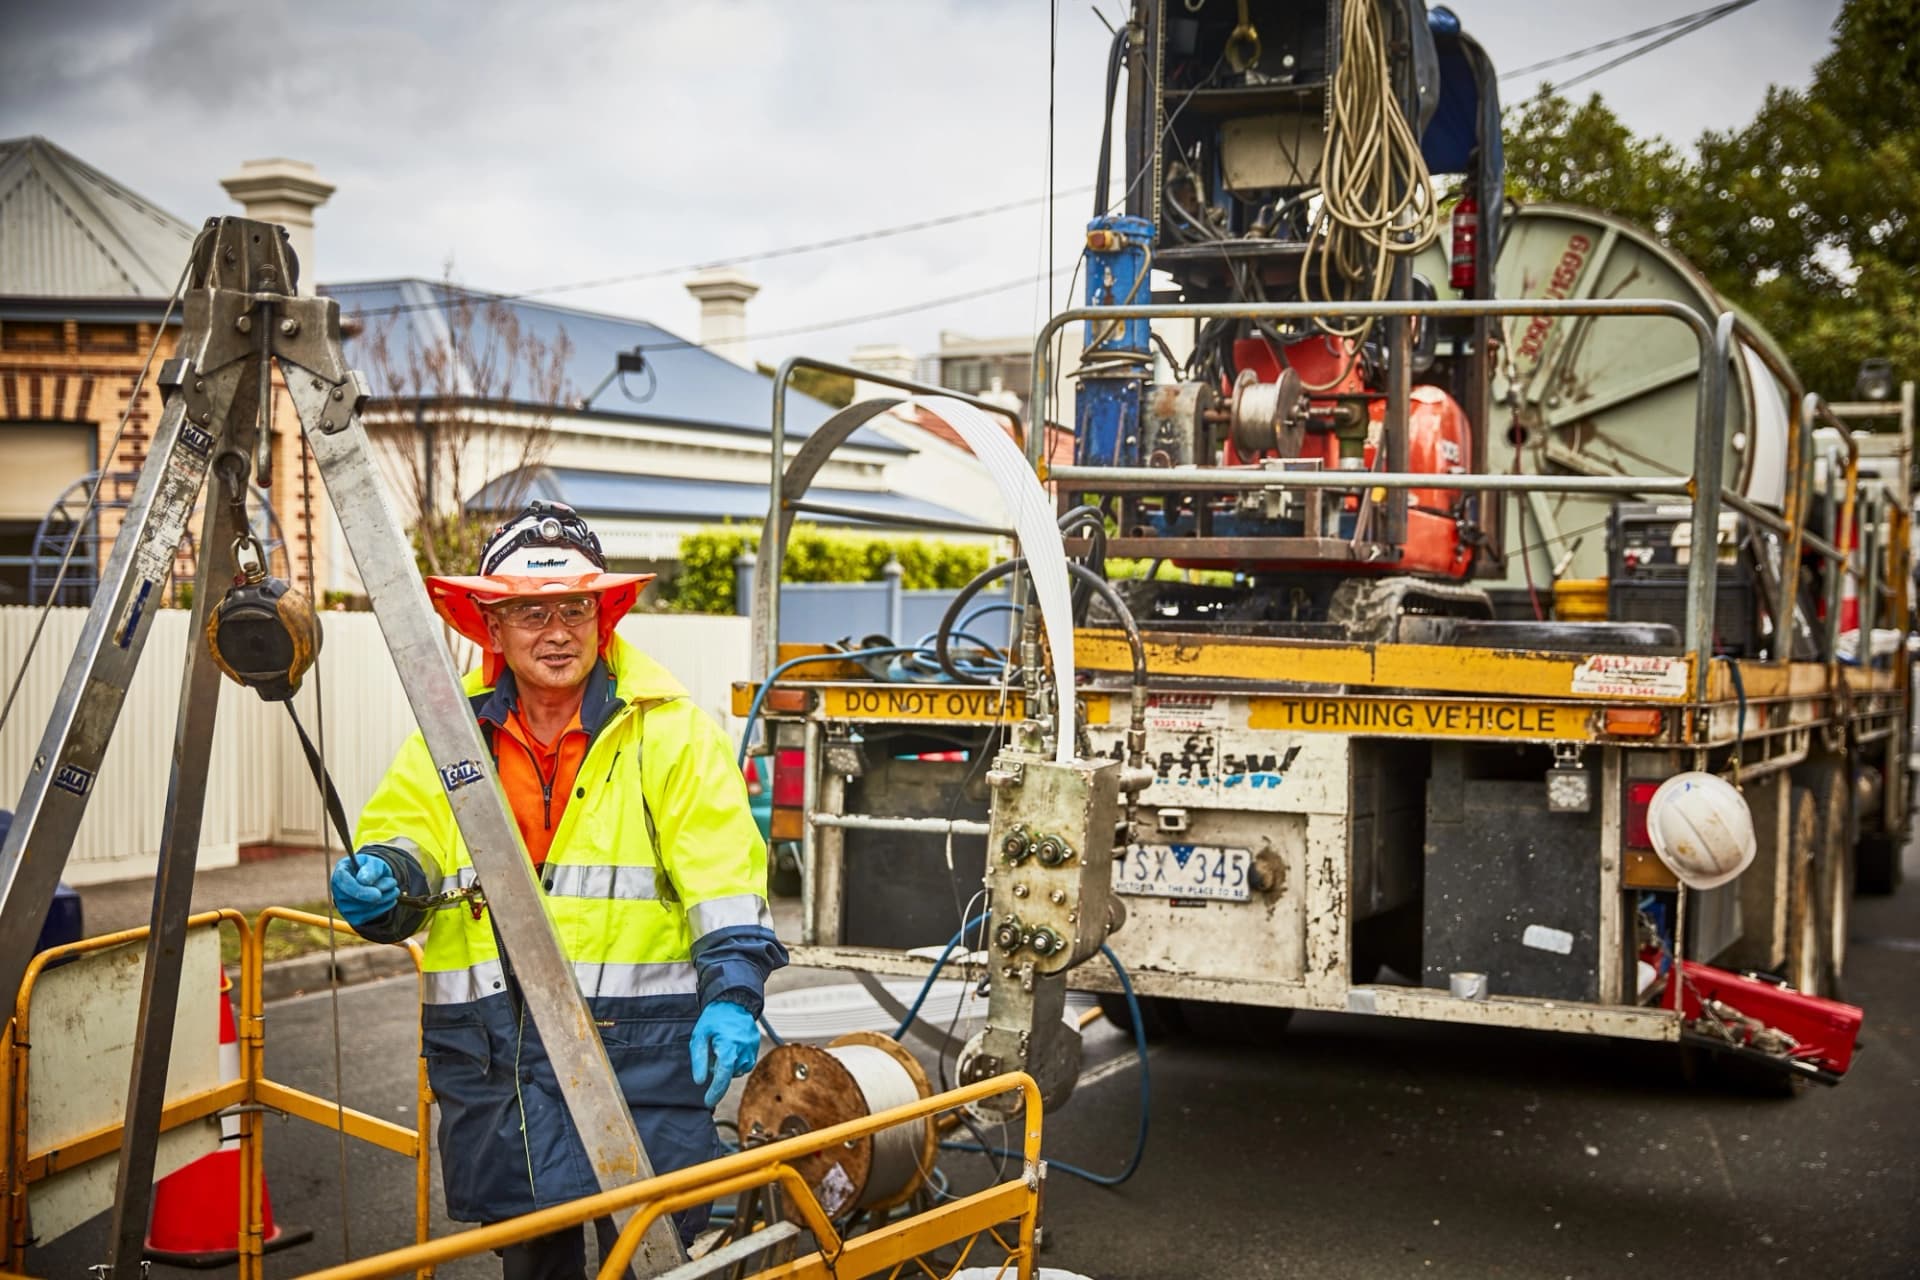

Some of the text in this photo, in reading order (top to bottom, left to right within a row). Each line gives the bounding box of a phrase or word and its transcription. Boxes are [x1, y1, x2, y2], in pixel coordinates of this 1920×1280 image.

[527, 558, 569, 568] Interflow
[846, 690, 880, 713] DO
[888, 691, 939, 715] NOT
[1282, 702, 1555, 732] TURNING VEHICLE
[57, 767, 87, 791] SALA
[449, 764, 479, 784] SALA
[1194, 853, 1244, 887] 345
